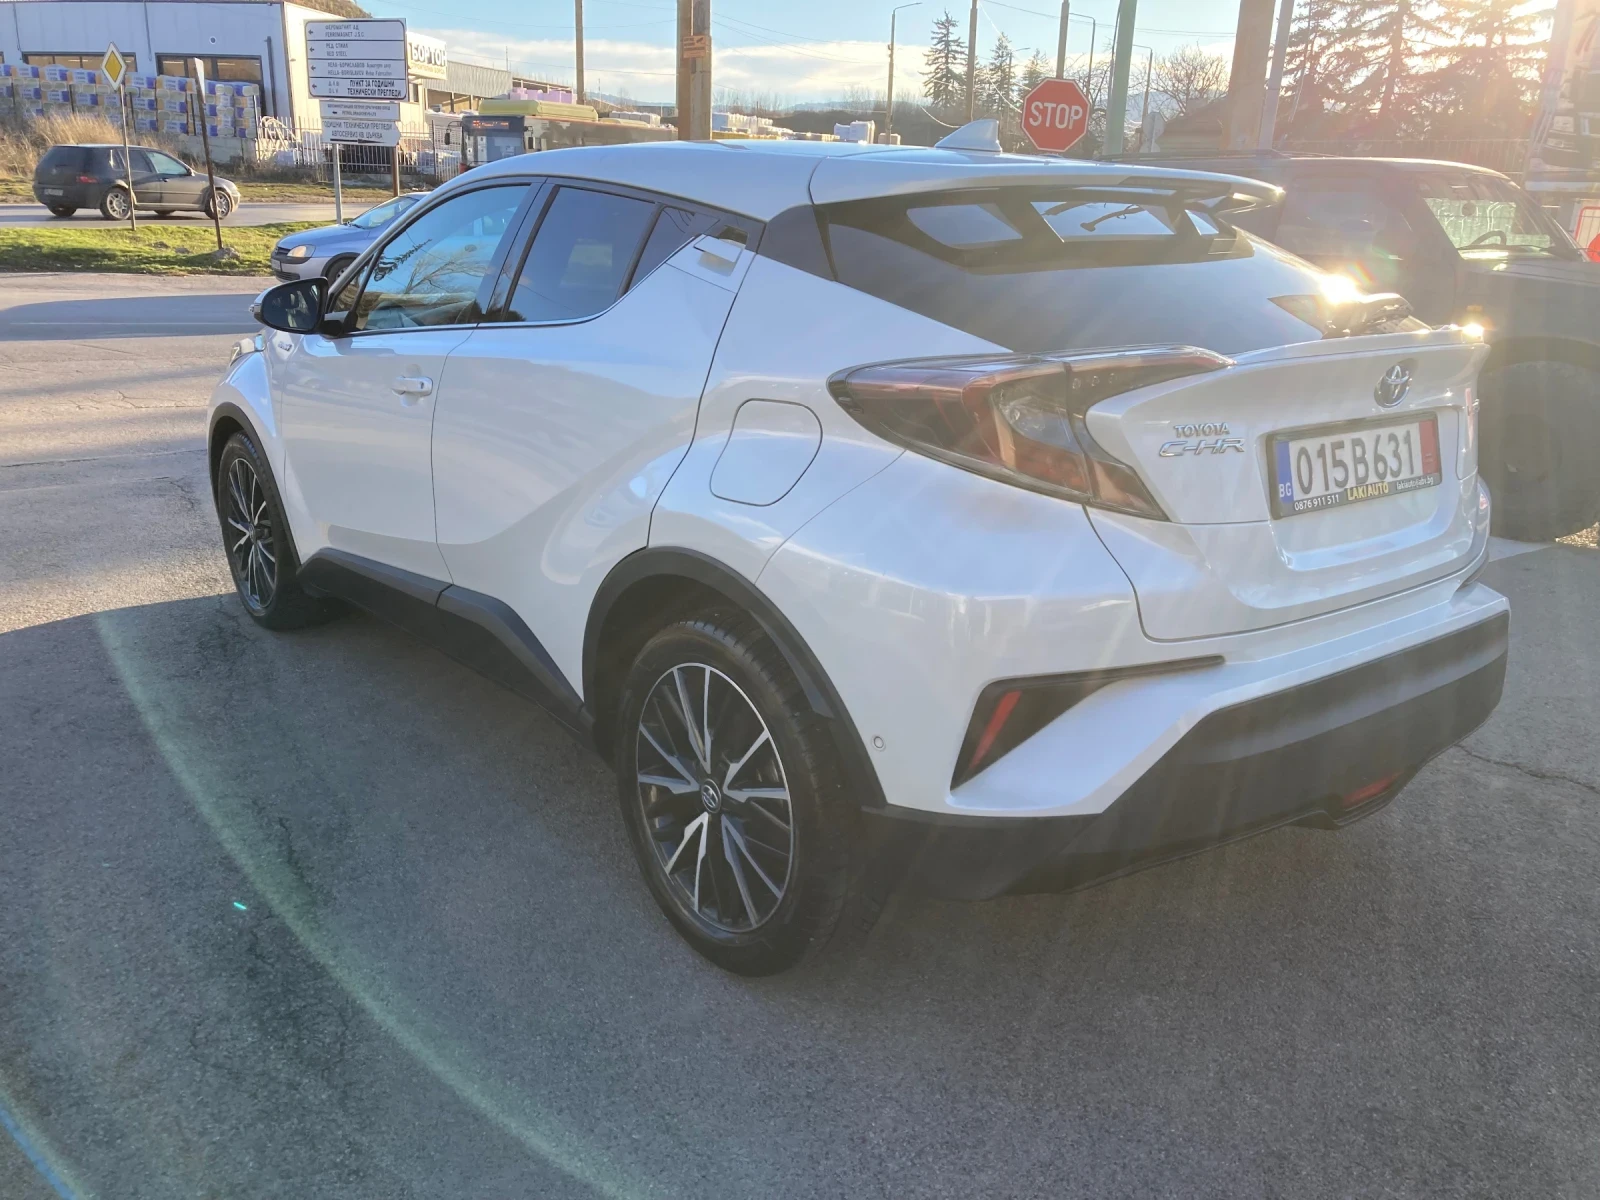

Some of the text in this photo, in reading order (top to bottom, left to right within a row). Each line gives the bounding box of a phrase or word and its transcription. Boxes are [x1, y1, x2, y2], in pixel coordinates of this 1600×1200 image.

[1029, 102, 1082, 129] STOP
[1174, 422, 1230, 438] TOYOTA
[1159, 438, 1246, 457] C-HR
[1296, 430, 1415, 494] 015B631
[1279, 482, 1292, 498] BG
[1294, 494, 1340, 511] 0876 911 511
